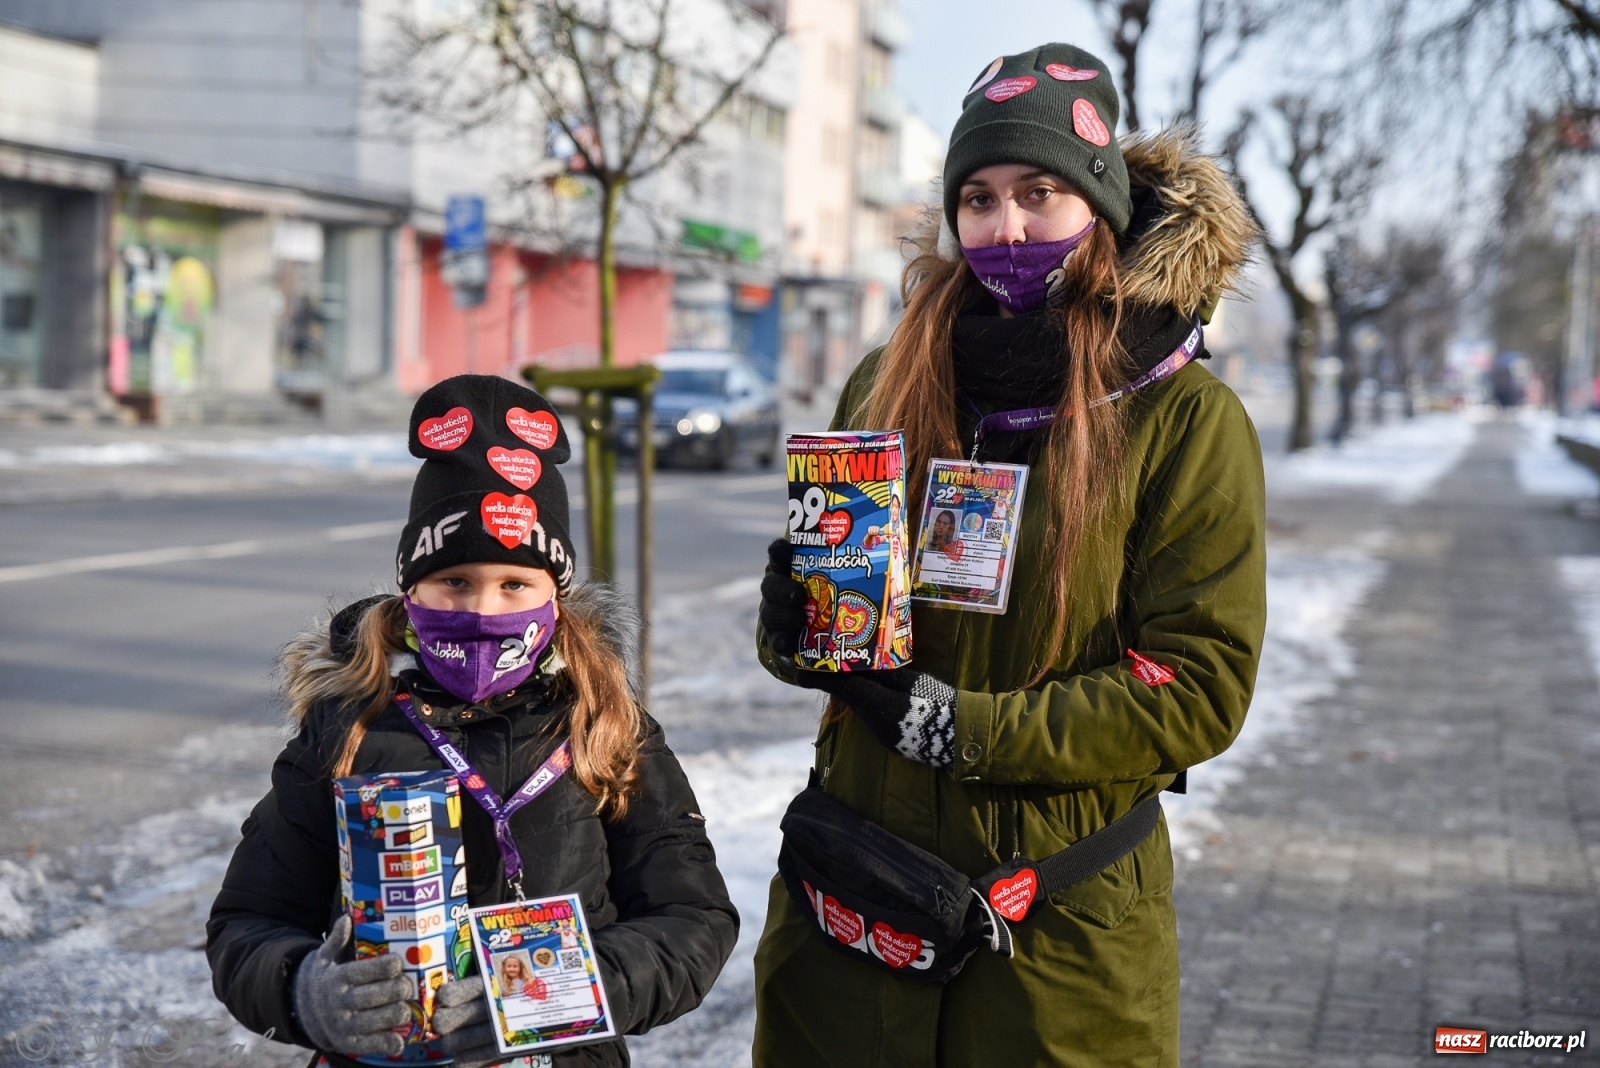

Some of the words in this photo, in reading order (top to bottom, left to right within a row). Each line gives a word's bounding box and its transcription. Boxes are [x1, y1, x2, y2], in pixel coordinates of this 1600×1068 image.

[423, 423, 443, 437] wielka
[443, 415, 468, 429] orkiestra
[431, 424, 467, 443] świątecznej
[509, 416, 528, 427] wielka
[528, 419, 552, 432] orkiestra
[439, 436, 462, 448] pomocy
[516, 426, 550, 443] świątecznej
[491, 454, 511, 463] wielka
[511, 455, 536, 465] orkiestra
[500, 463, 535, 478] świątecznej
[509, 473, 532, 484] pomocy
[935, 486, 957, 502] 29
[485, 501, 506, 513] wielka
[506, 504, 532, 517] orkiestra
[491, 514, 528, 531] świątecznej
[499, 527, 523, 541] pomocy
[818, 543, 872, 578] radością
[833, 632, 872, 670] głową
[443, 747, 465, 768] PLAY
[526, 772, 548, 793] PLAY
[403, 803, 427, 816] onet
[389, 855, 435, 873] mBank
[389, 884, 437, 903] PLAY
[993, 886, 1011, 902] wielka
[1010, 876, 1032, 892] orkiestra
[1000, 886, 1031, 909] świątecznej
[481, 905, 572, 931] WYGRYWAMY
[825, 903, 840, 917] wielka
[840, 911, 859, 930] orkiestra
[1008, 900, 1027, 918] pomocy
[389, 913, 442, 934] allegro
[828, 913, 856, 939] świątecznej
[489, 928, 512, 950] 29
[833, 925, 851, 942] pomocy
[875, 927, 892, 942] wielka
[892, 938, 917, 951] orkiestra
[878, 938, 911, 961] świątecznej
[882, 948, 904, 966] pomocy
